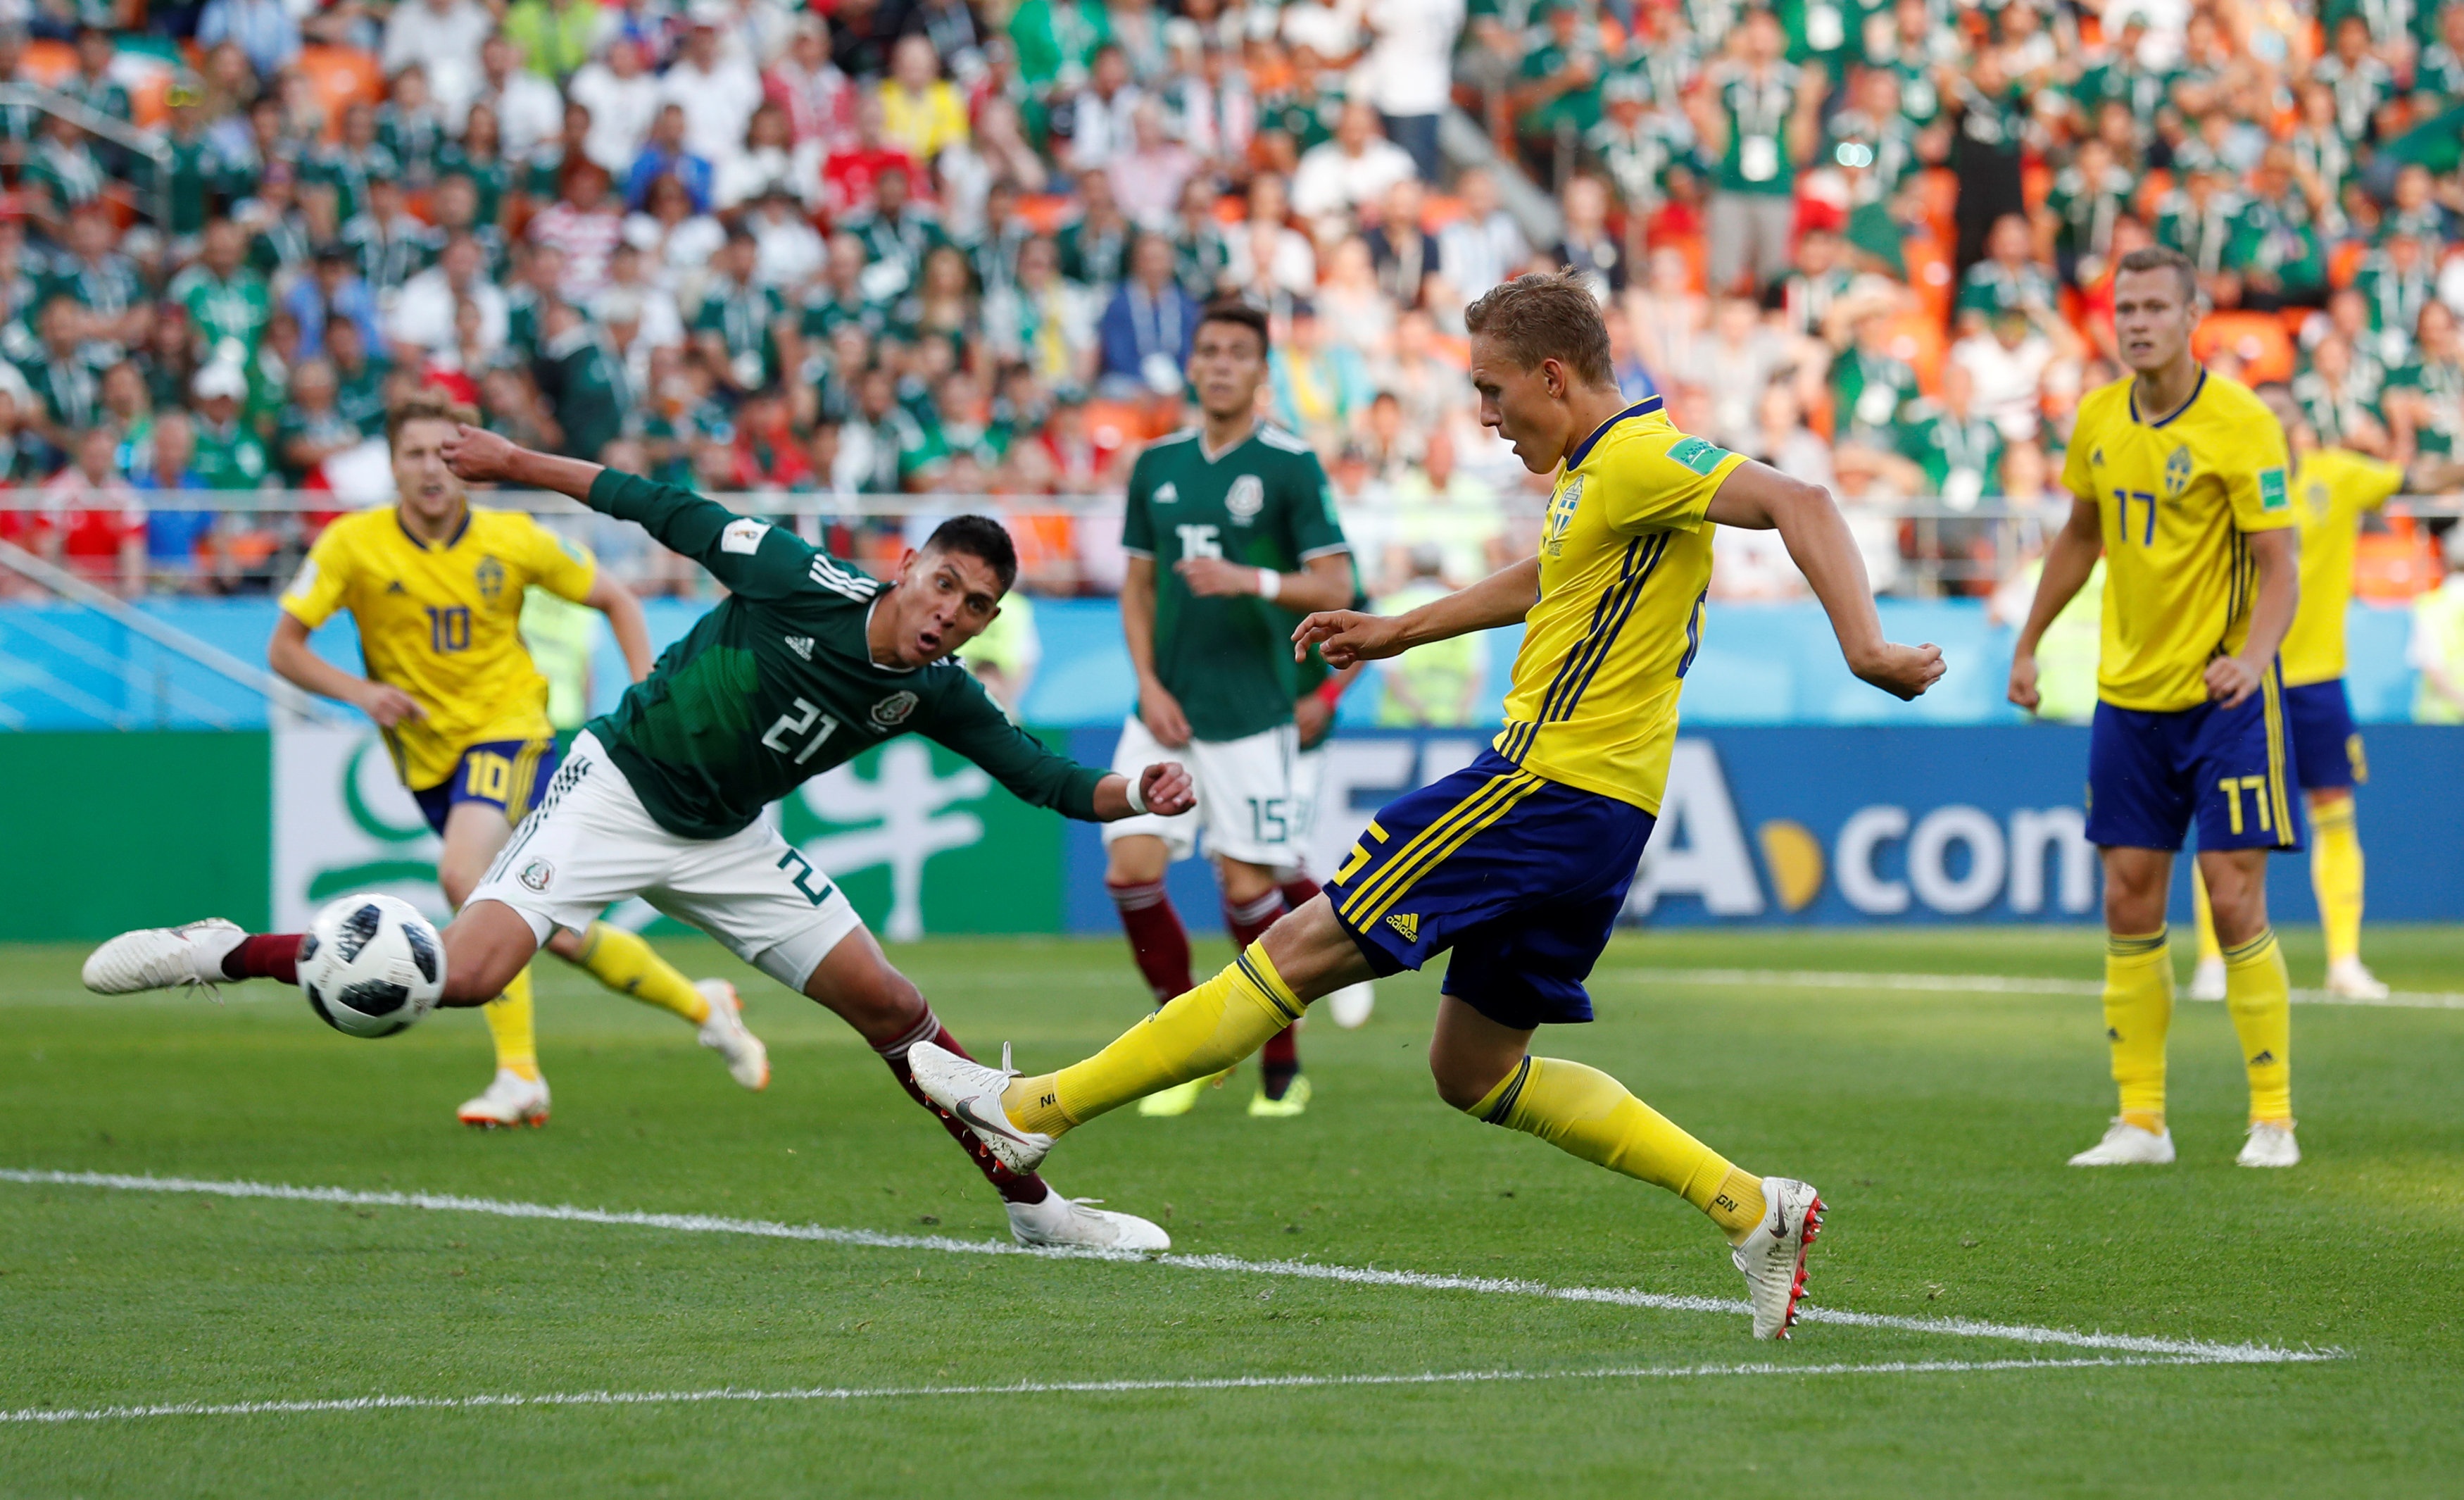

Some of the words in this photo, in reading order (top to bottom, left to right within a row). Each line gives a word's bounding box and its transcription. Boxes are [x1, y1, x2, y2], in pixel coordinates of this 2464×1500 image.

[2113, 489, 2156, 546] 17
[426, 606, 470, 652] 10
[761, 696, 839, 765] 21
[465, 751, 510, 802] 10
[1246, 798, 1287, 843] 15
[2219, 775, 2271, 835] 17
[1385, 915, 1419, 943] adidas
[1715, 1194, 1739, 1213] GN
